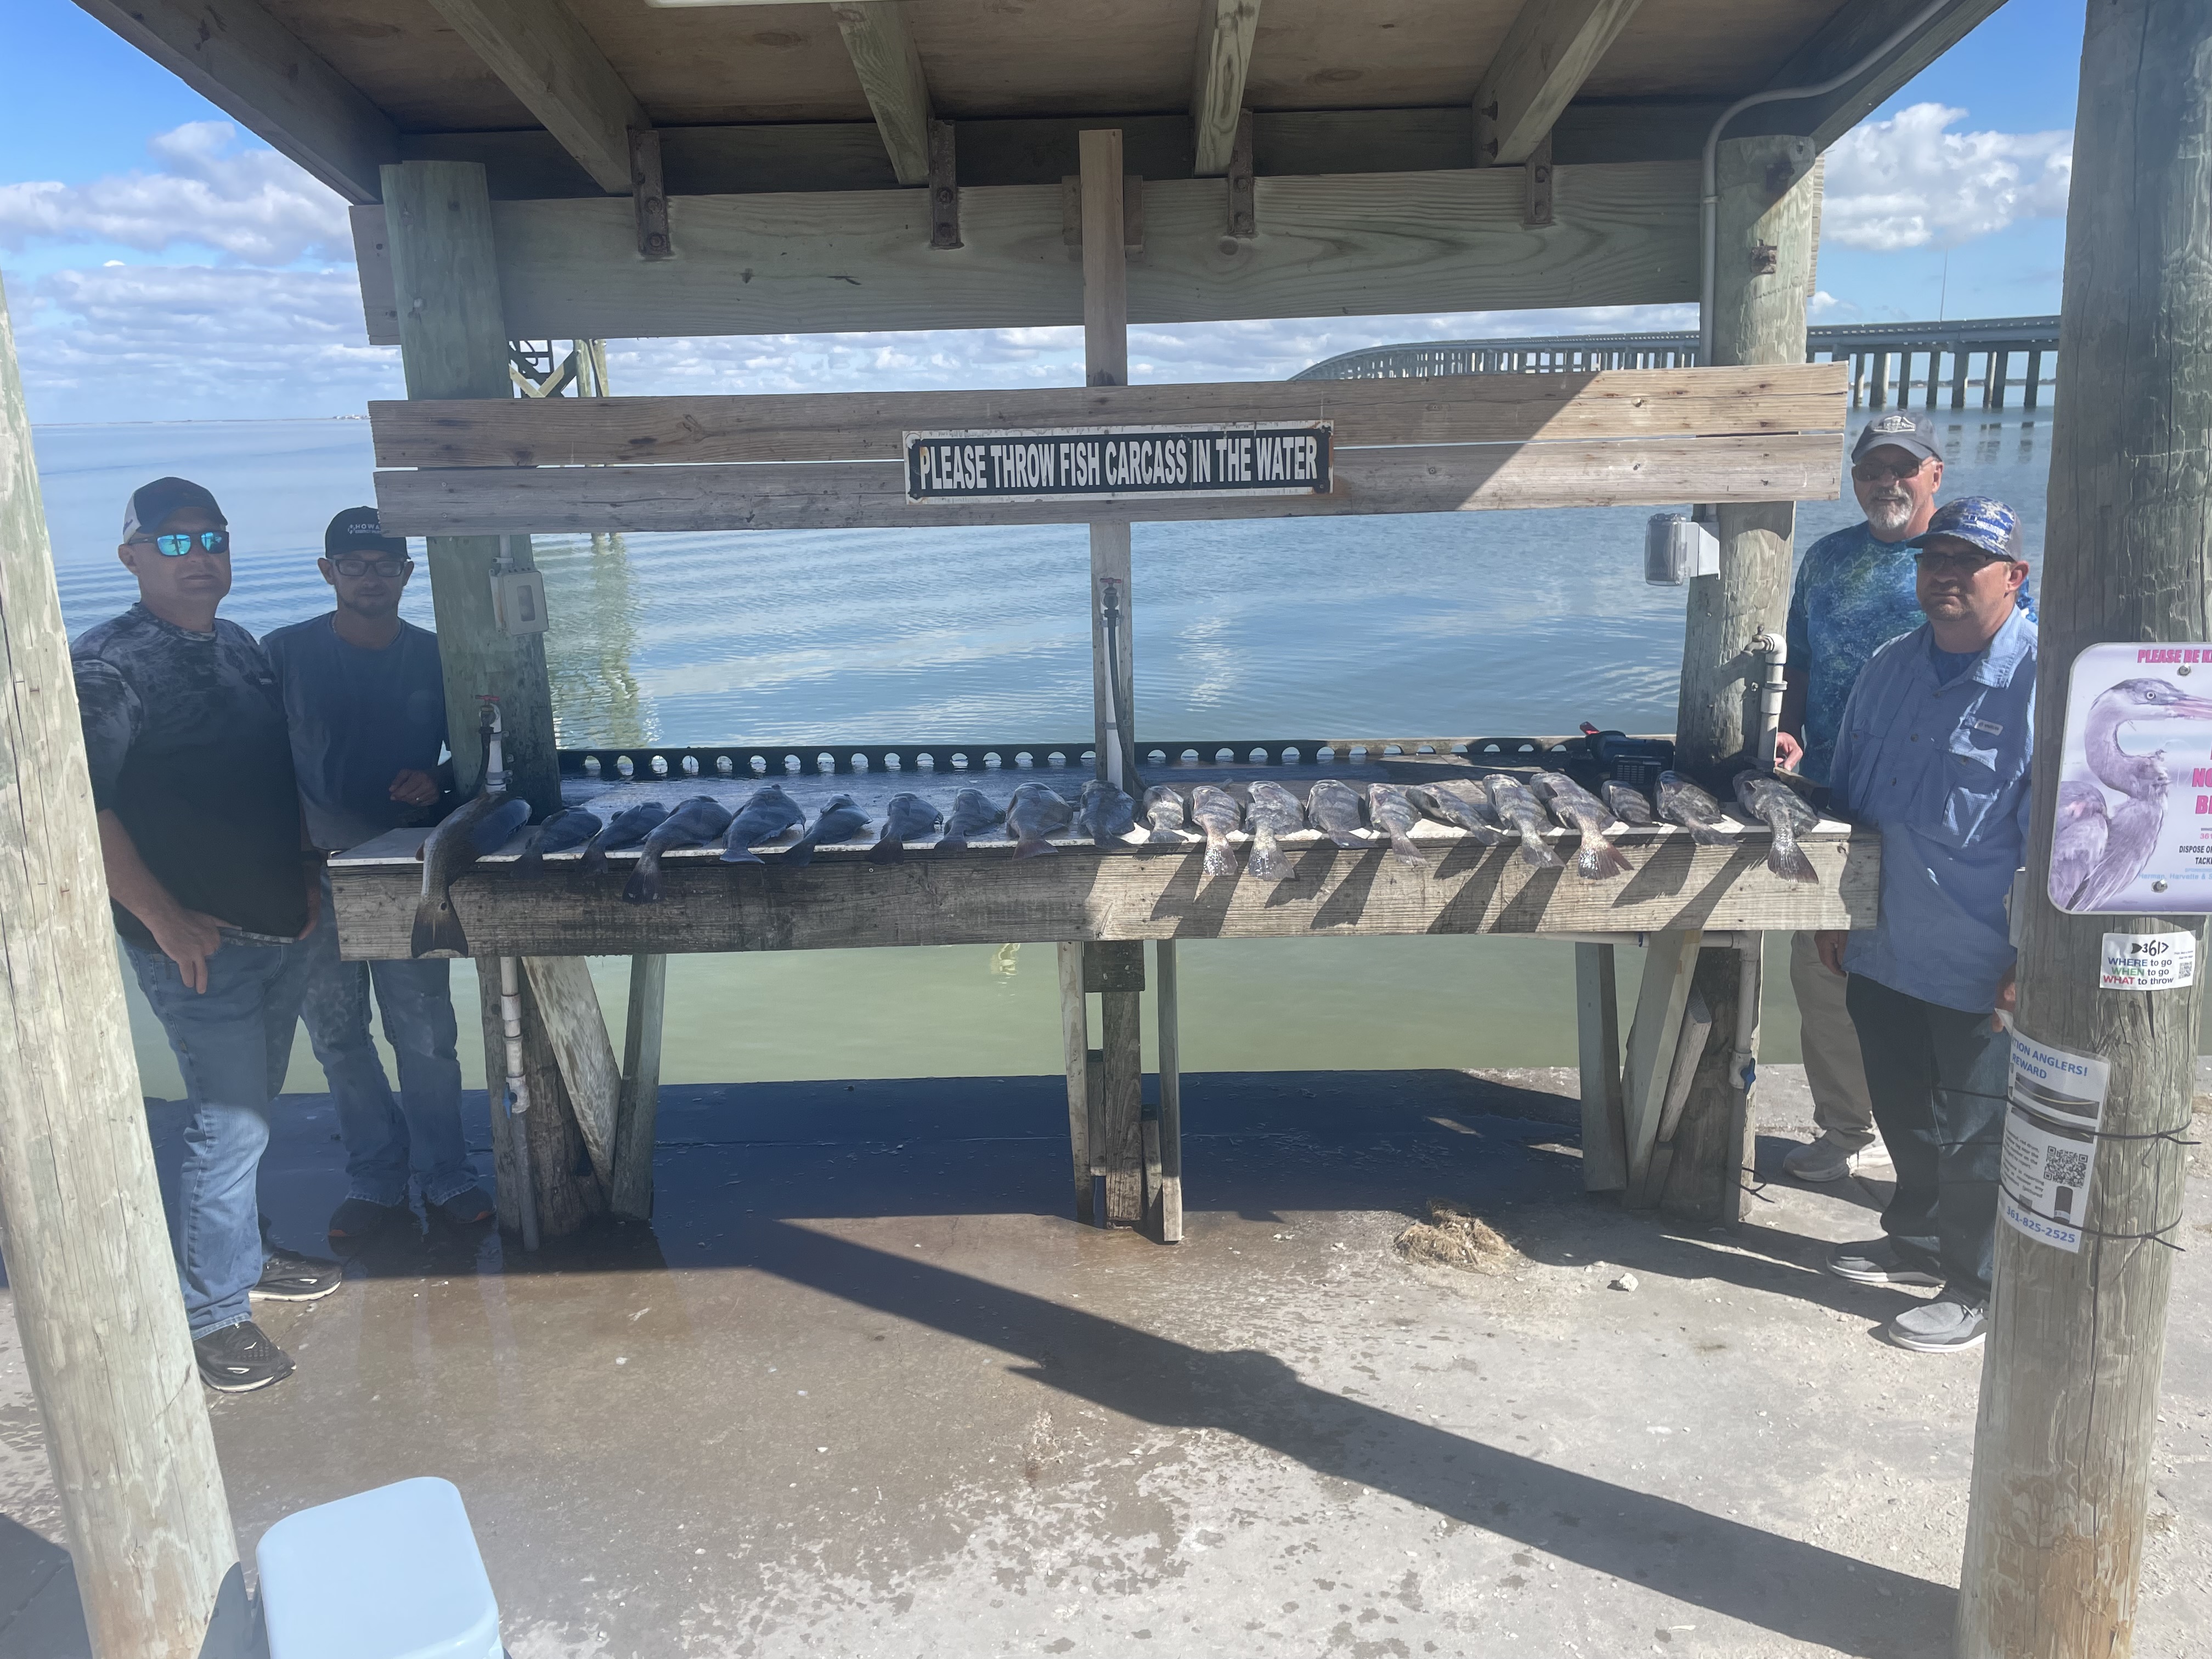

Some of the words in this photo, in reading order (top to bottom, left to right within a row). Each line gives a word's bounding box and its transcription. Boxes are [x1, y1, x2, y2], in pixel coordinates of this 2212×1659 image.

[919, 445, 987, 489] PLEASE
[990, 443, 1054, 488] THROW
[1060, 442, 1100, 487] FISH
[1105, 439, 1187, 486] CARCASS
[1192, 439, 1211, 483] IN
[1216, 438, 1251, 482] THE
[1255, 436, 1317, 481] WATER
[2137, 649, 2182, 663] PLEASE
[2183, 649, 2200, 663] BE
[2179, 845, 2205, 854] DISPOSE
[2108, 957, 2148, 967] WHERE
[2112, 967, 2145, 976] WHEN
[2103, 975, 2135, 985] WHAT
[2012, 1053, 2047, 1079] REWARD
[2032, 1051, 2088, 1076] ANGLERS!
[2007, 1206, 2075, 1243] 361-825-2525
